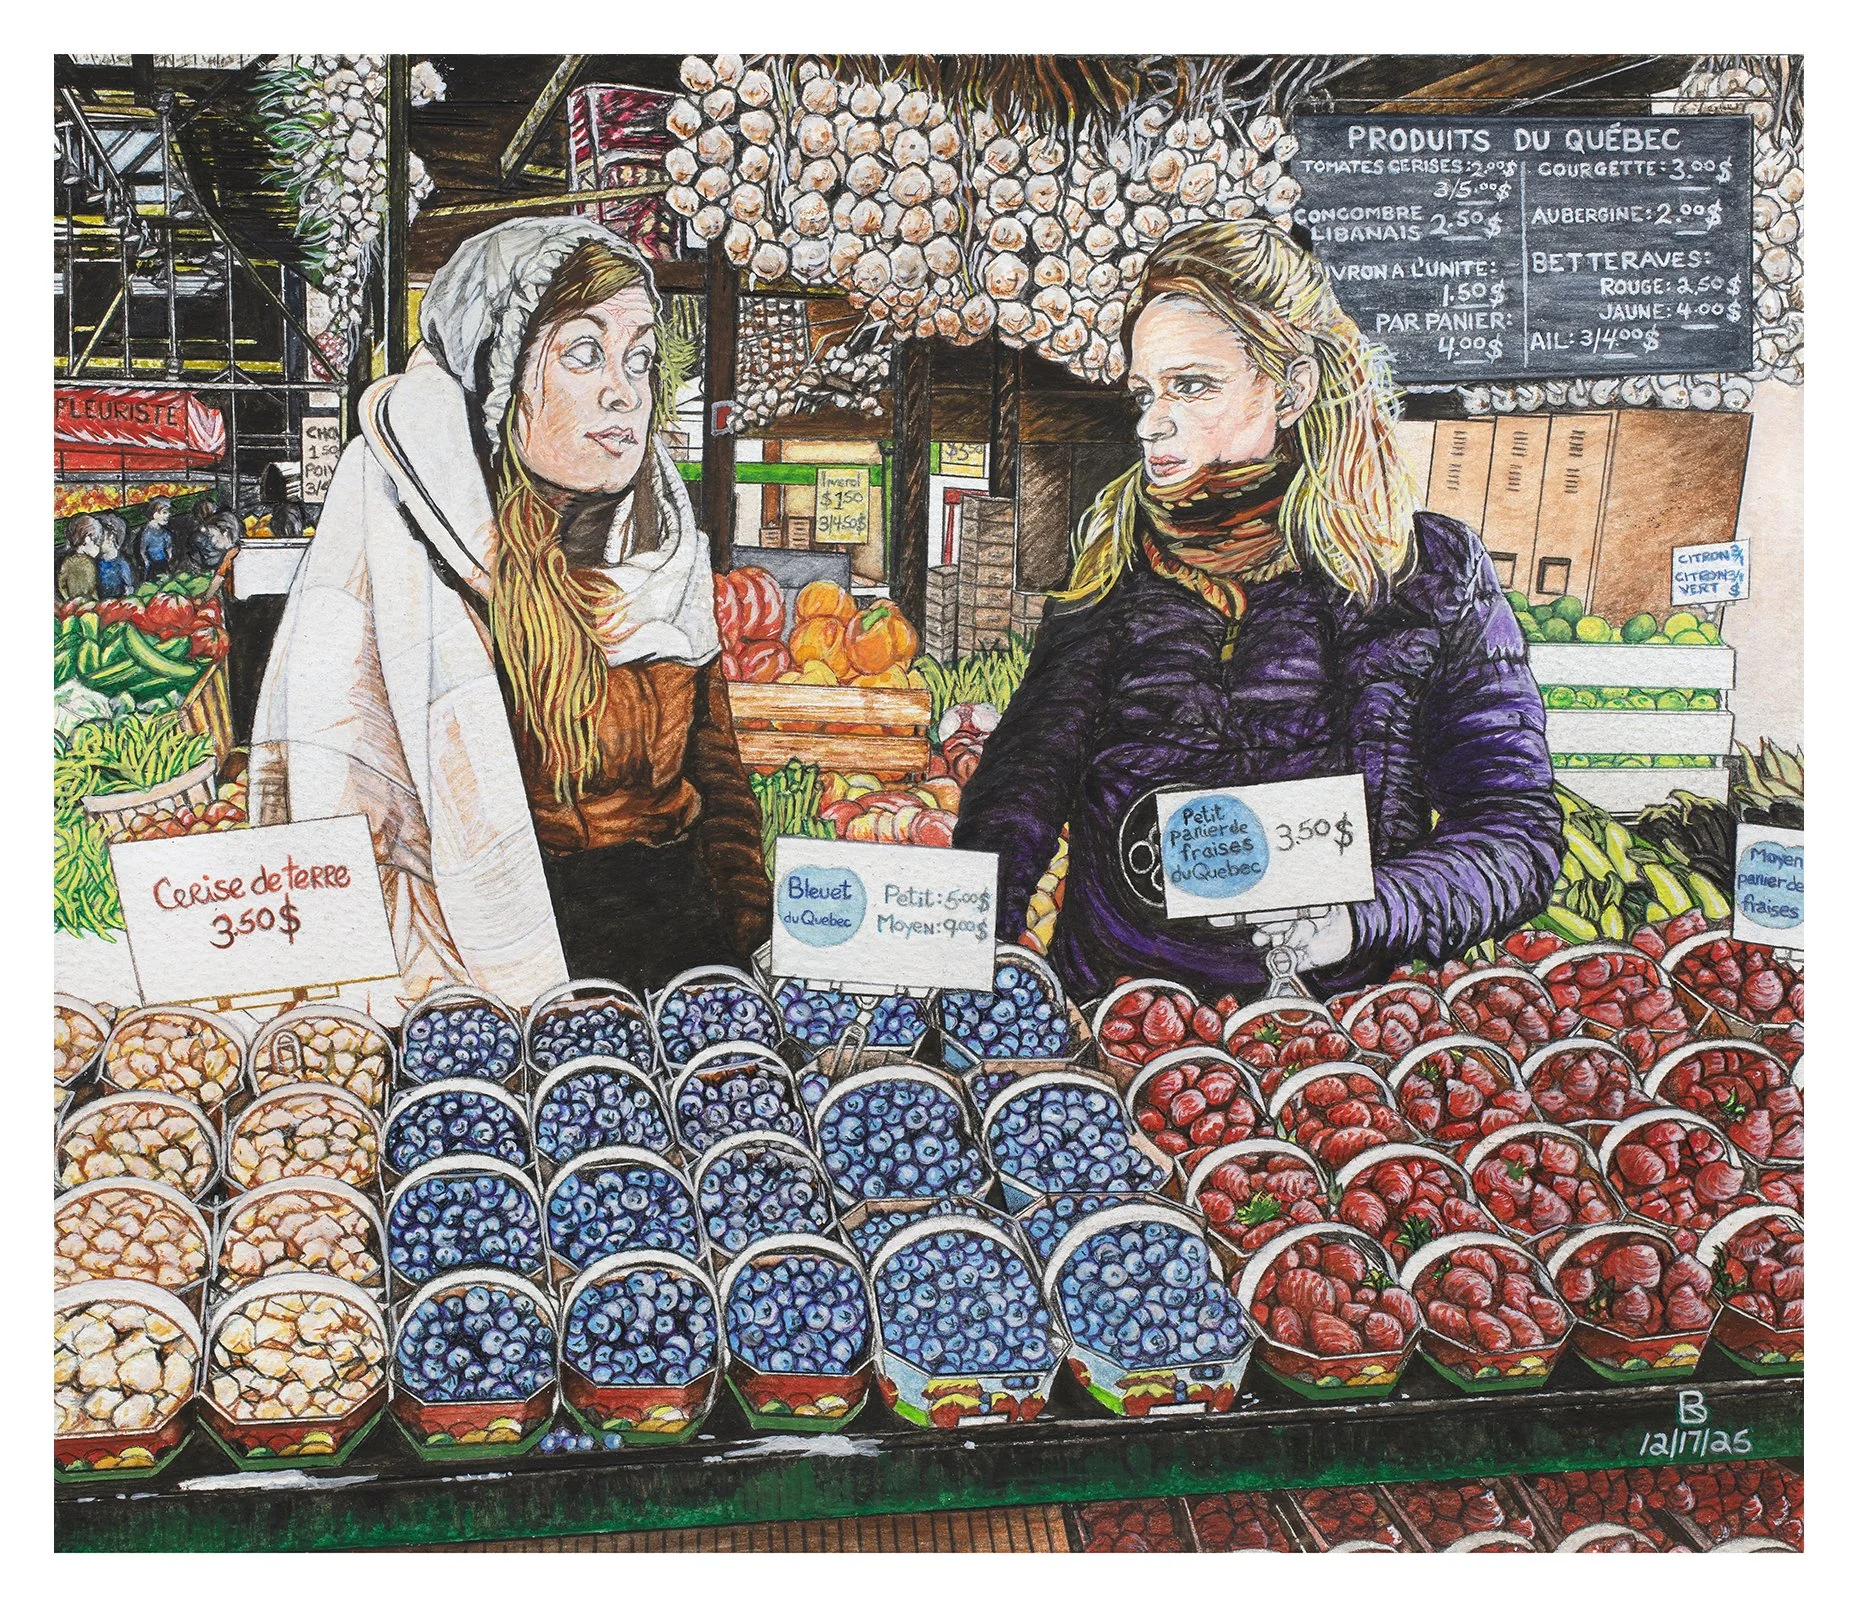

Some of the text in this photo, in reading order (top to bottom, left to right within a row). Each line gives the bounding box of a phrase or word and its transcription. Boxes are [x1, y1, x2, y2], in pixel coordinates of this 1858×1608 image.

[1348, 122, 1681, 154] PRODUITS DU QUÉBEC
[1300, 159, 1384, 175] TOMATES
[1538, 160, 1666, 179] COURGETTE:
[1293, 205, 1423, 226] CONCOMBRE
[1531, 205, 1651, 226] AUBERGINE:
[1310, 225, 1422, 242] LIBANAIS
[1531, 250, 1711, 274] BETTERAVES:
[1600, 277, 1671, 297] ROUGE:
[1376, 311, 1513, 334] PAR PANIER:
[1600, 303, 1671, 321] JAUNE:
[1530, 331, 1574, 351] AIL:
[55, 397, 181, 427] FLEURISTE
[1678, 550, 1730, 564] CITRON
[1679, 583, 1720, 596] VERT
[1183, 804, 1225, 825] Petit
[1170, 819, 1248, 845] panier de
[1179, 837, 1255, 862] fraises
[1750, 848, 1804, 870] Moyen
[250, 864, 282, 895] de
[1172, 859, 1262, 884] du Quebec
[788, 876, 852, 900] Bleuet
[1786, 875, 1804, 892] de
[884, 884, 942, 908] Petit:
[1741, 894, 1799, 919] fraises
[783, 910, 852, 928] du Quebec
[1639, 1428, 1753, 1459] 12/17/25
